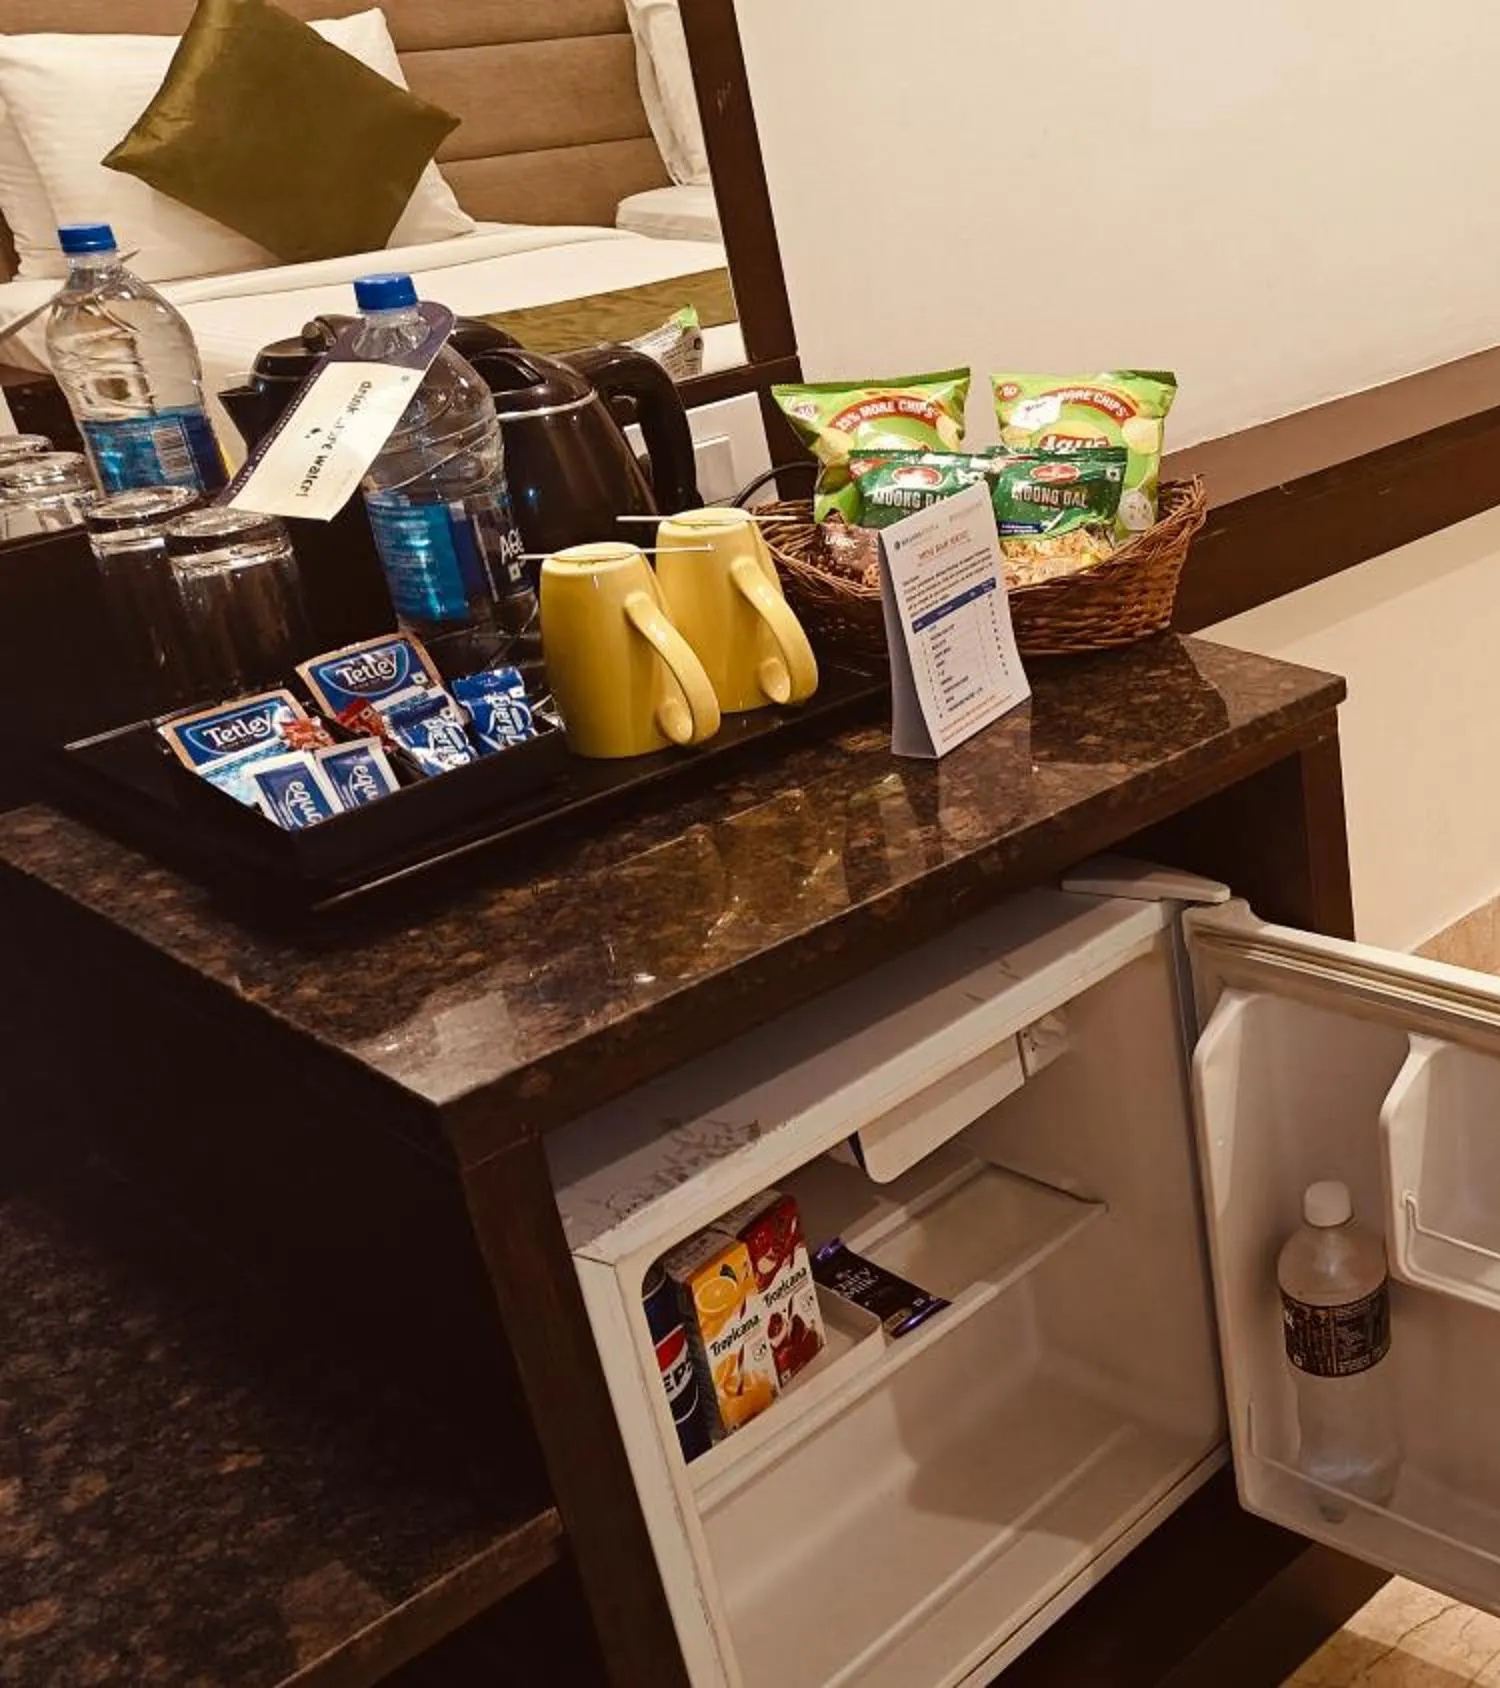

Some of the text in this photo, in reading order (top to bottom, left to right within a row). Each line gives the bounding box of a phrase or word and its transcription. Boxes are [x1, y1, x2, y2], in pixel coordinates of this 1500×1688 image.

[347, 381, 373, 414] drink
[1063, 490, 1089, 508] DAL
[336, 652, 398, 687] Tetley
[202, 709, 273, 748] Tetley
[763, 1267, 807, 1308] Tropicana
[709, 1314, 760, 1357] Tropicana
